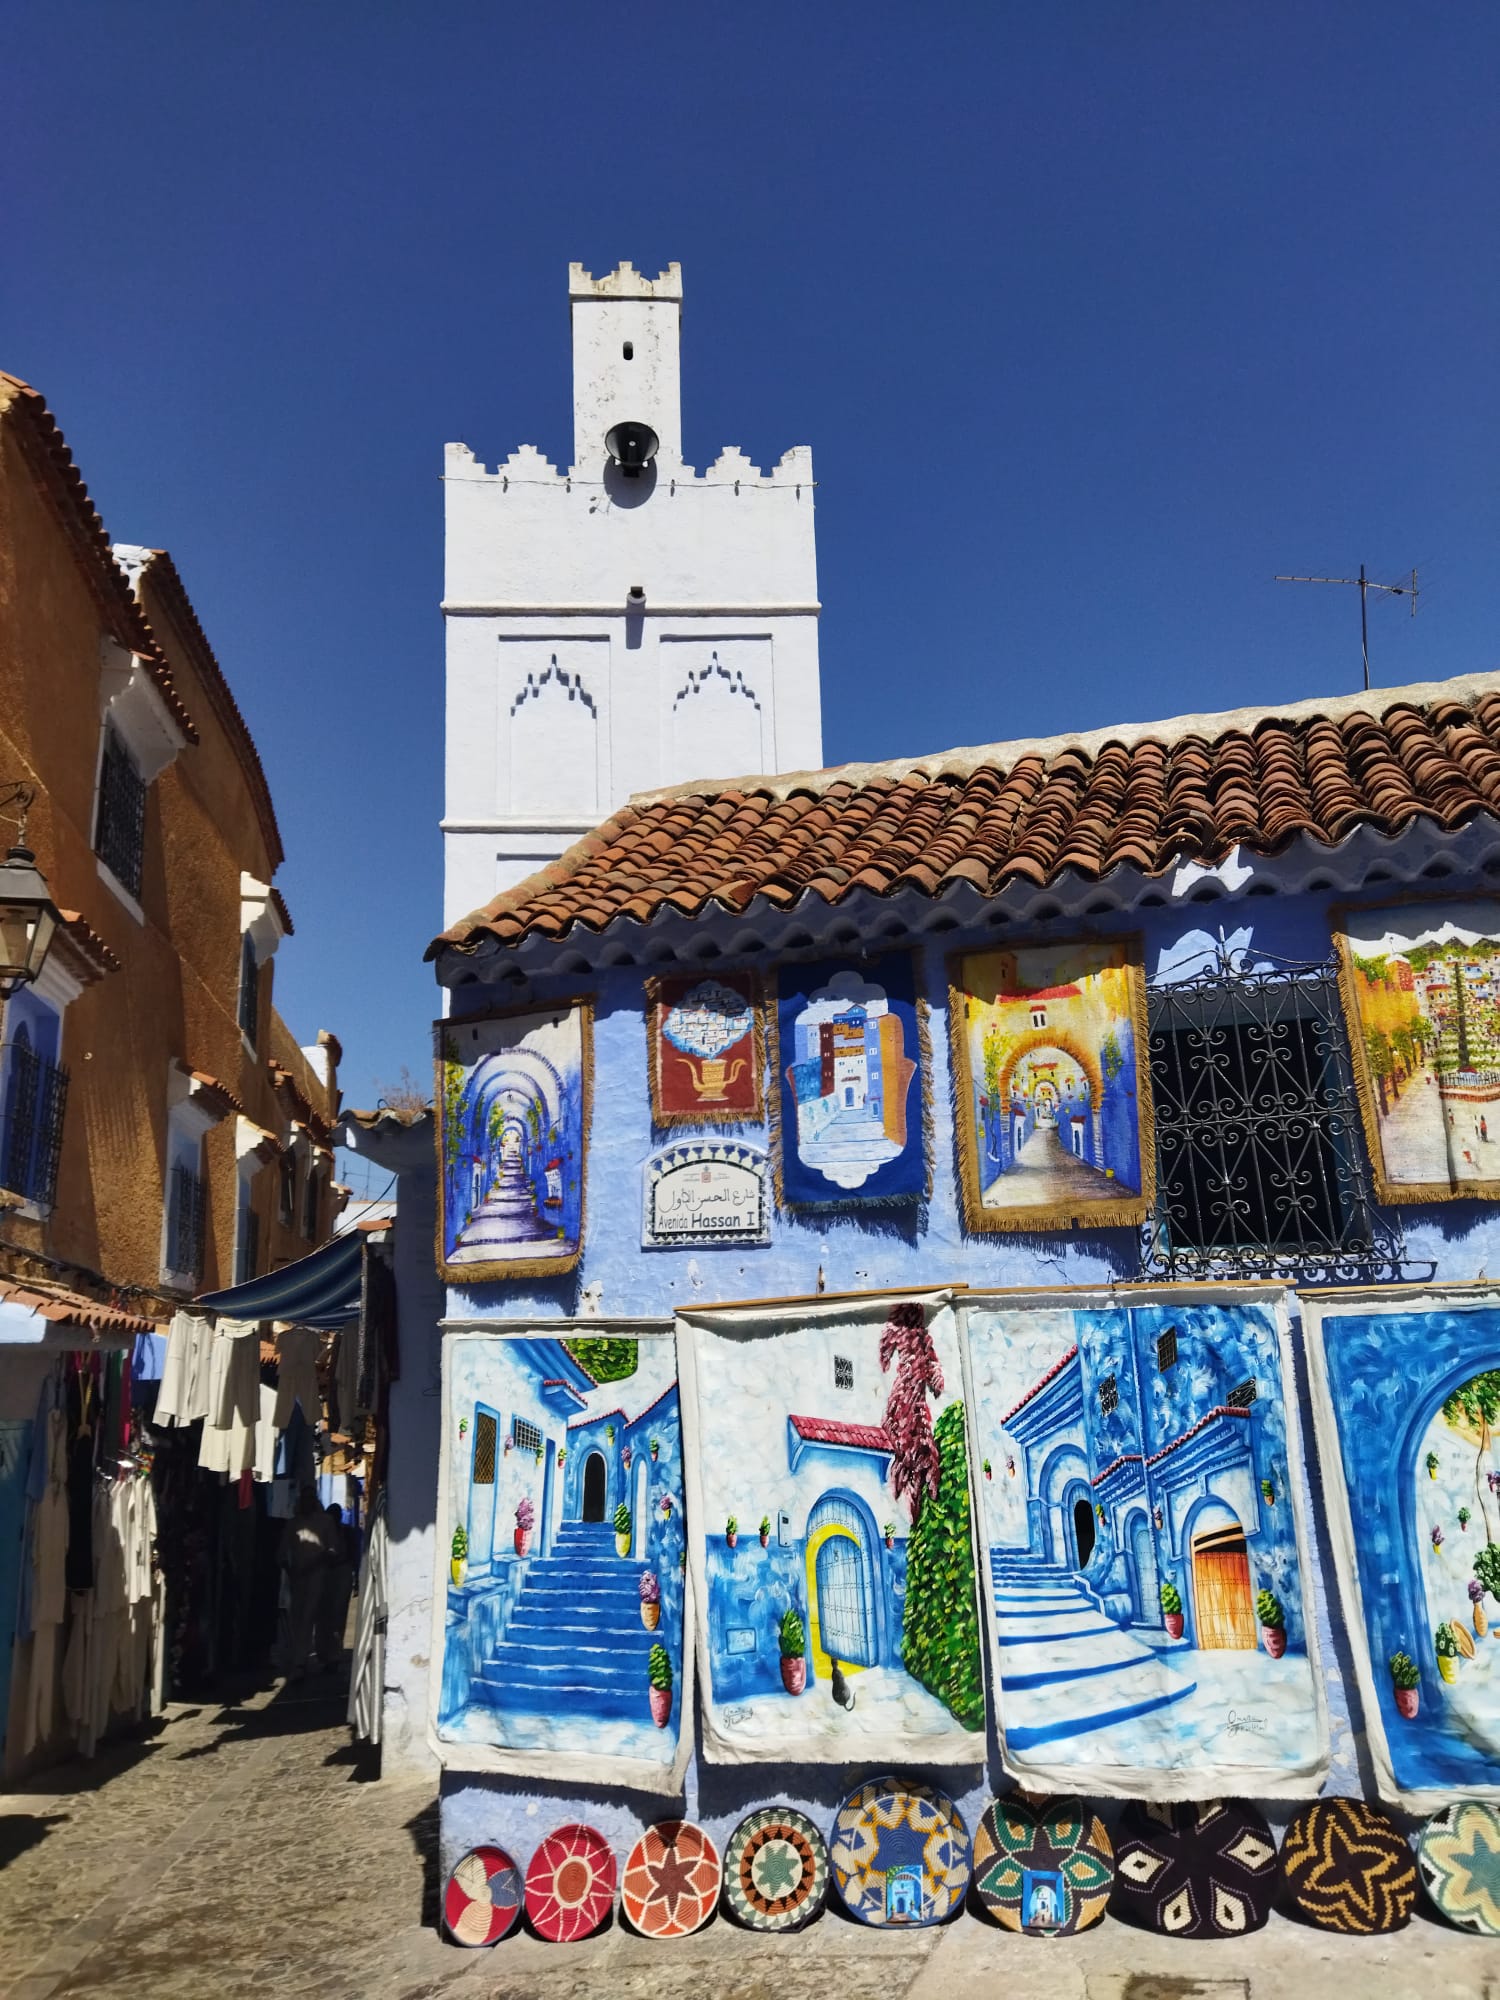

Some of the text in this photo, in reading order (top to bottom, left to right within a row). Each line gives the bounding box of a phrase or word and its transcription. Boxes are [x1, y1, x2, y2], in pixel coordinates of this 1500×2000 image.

[686, 1188, 730, 1212] الحسن
[732, 1189, 755, 1206] شارع
[658, 1211, 755, 1230] Avenida Hassan I
